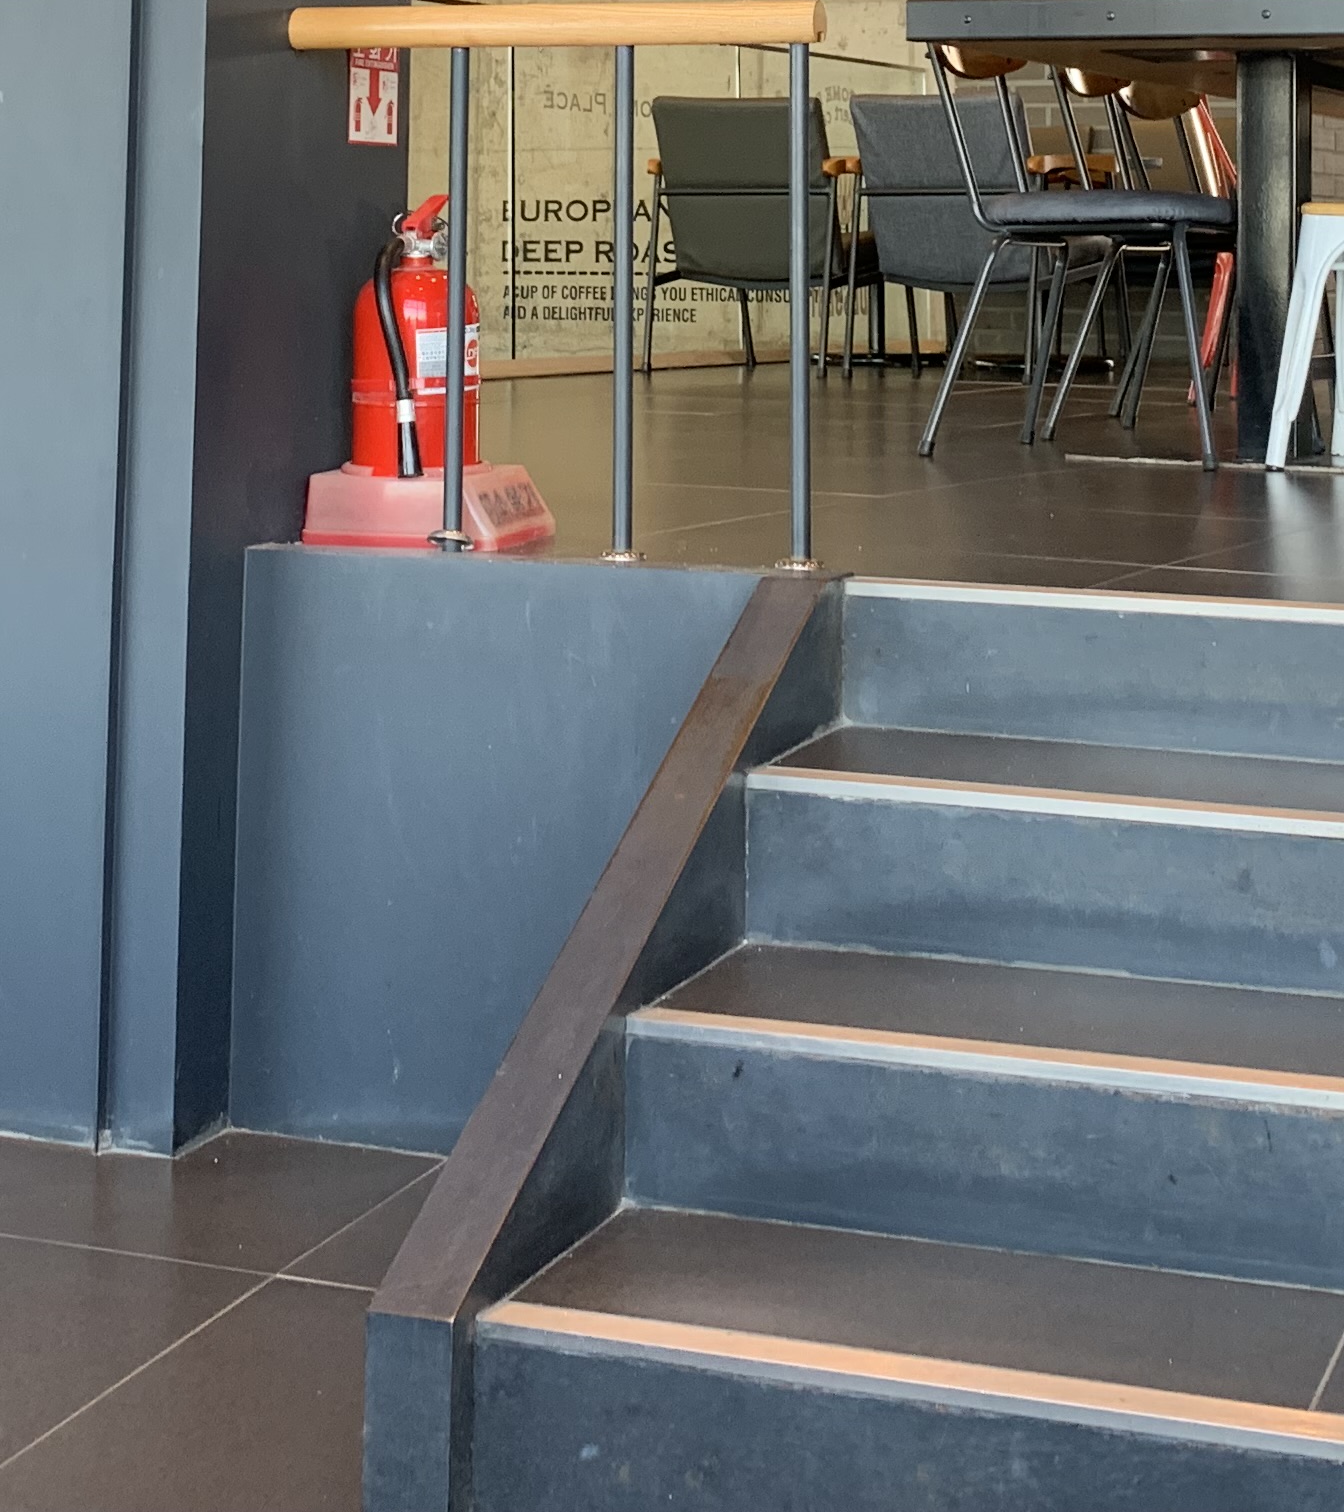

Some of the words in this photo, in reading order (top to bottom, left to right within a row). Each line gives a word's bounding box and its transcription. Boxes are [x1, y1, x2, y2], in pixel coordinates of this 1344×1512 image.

[542, 285, 558, 300] OF
[561, 285, 607, 301] COFFEE
[661, 286, 687, 302] YOU
[503, 305, 527, 320] AD
[530, 306, 539, 320] A
